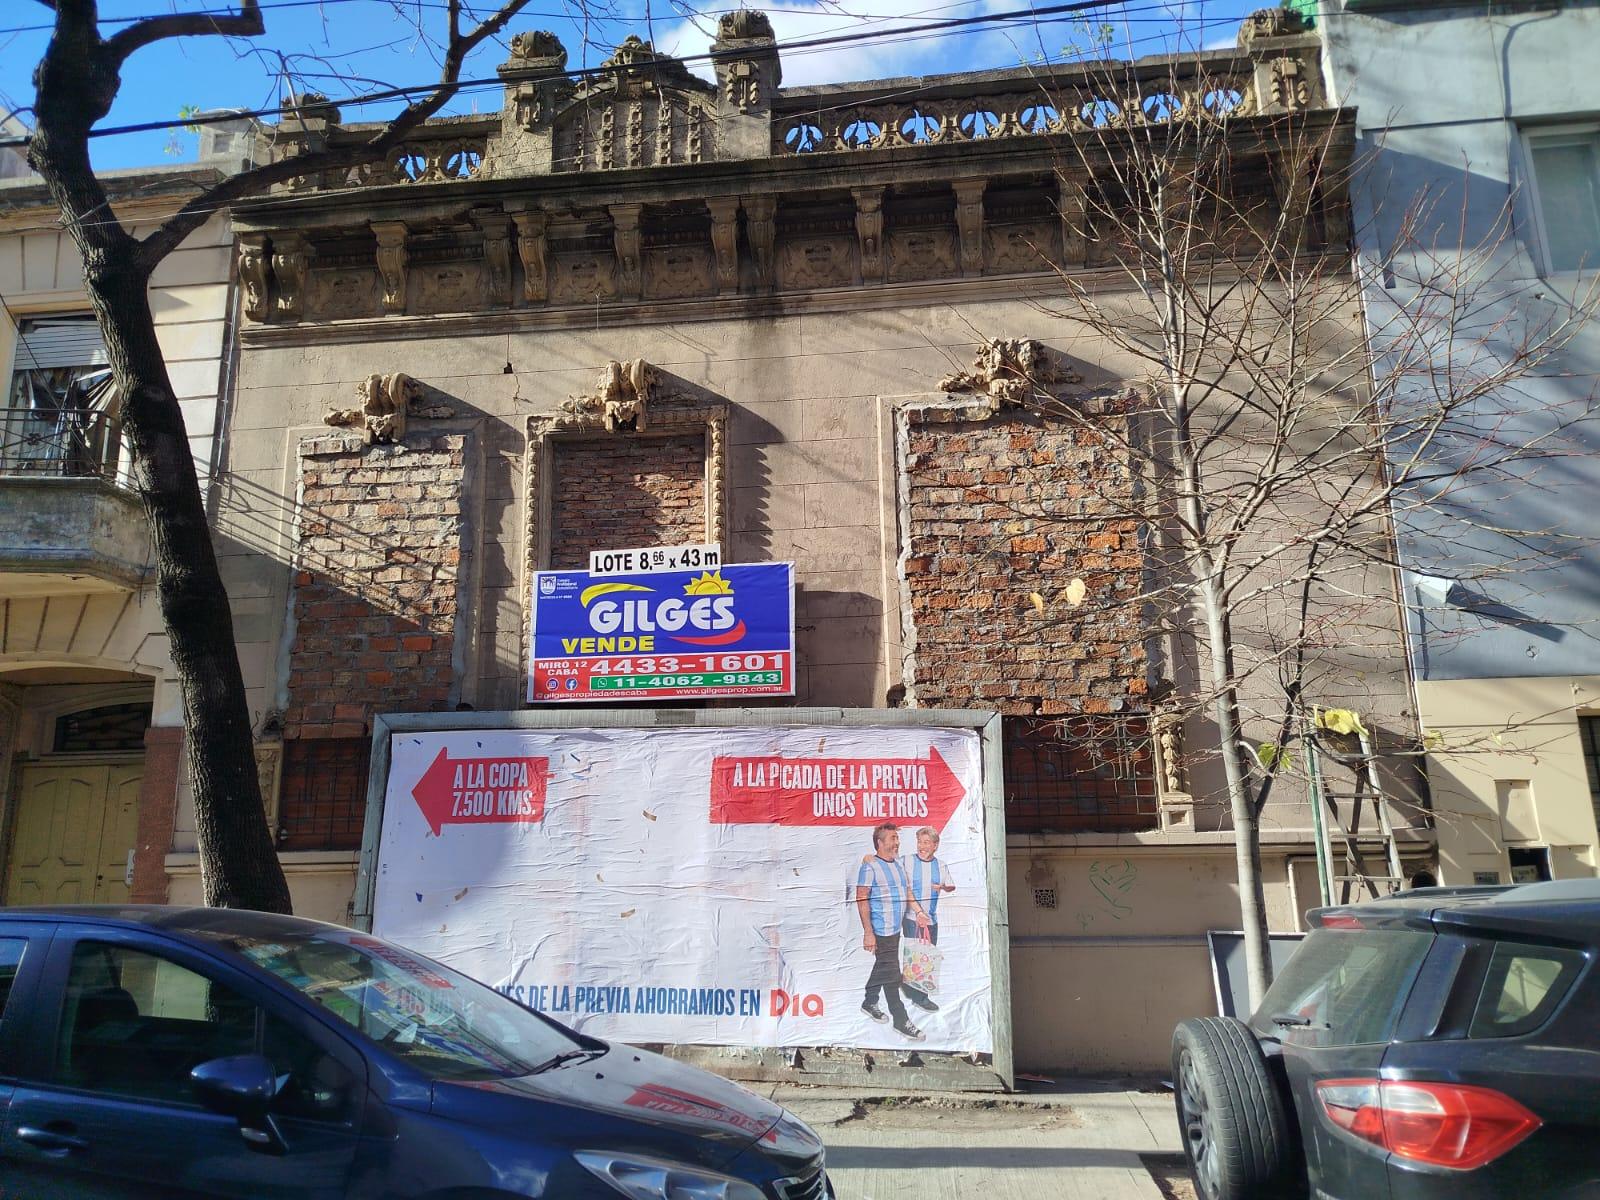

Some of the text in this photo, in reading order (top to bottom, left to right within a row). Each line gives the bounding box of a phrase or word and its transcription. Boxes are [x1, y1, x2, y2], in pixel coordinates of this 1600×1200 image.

[594, 553, 633, 573] LOTE
[680, 549, 701, 567] 43
[704, 551, 719, 566] m
[589, 597, 735, 633] GILGES
[561, 635, 656, 655] VENDE
[574, 661, 588, 669] 12
[590, 654, 783, 675] 4433-1601
[613, 675, 704, 688] 11-4062
[453, 762, 529, 789] A LA COPA
[733, 763, 743, 788] A
[747, 762, 766, 788] LA
[826, 765, 846, 790] DE
[849, 765, 869, 790] LA
[872, 764, 929, 790] PREVIA
[451, 790, 537, 817] 7.500 KMS.
[813, 791, 929, 818] UNOS METROS
[528, 985, 549, 1012] DE
[551, 985, 571, 1012] LA
[574, 985, 631, 1014] PREVIA
[634, 986, 737, 1016] AHORRAMOS
[739, 988, 761, 1017] EN
